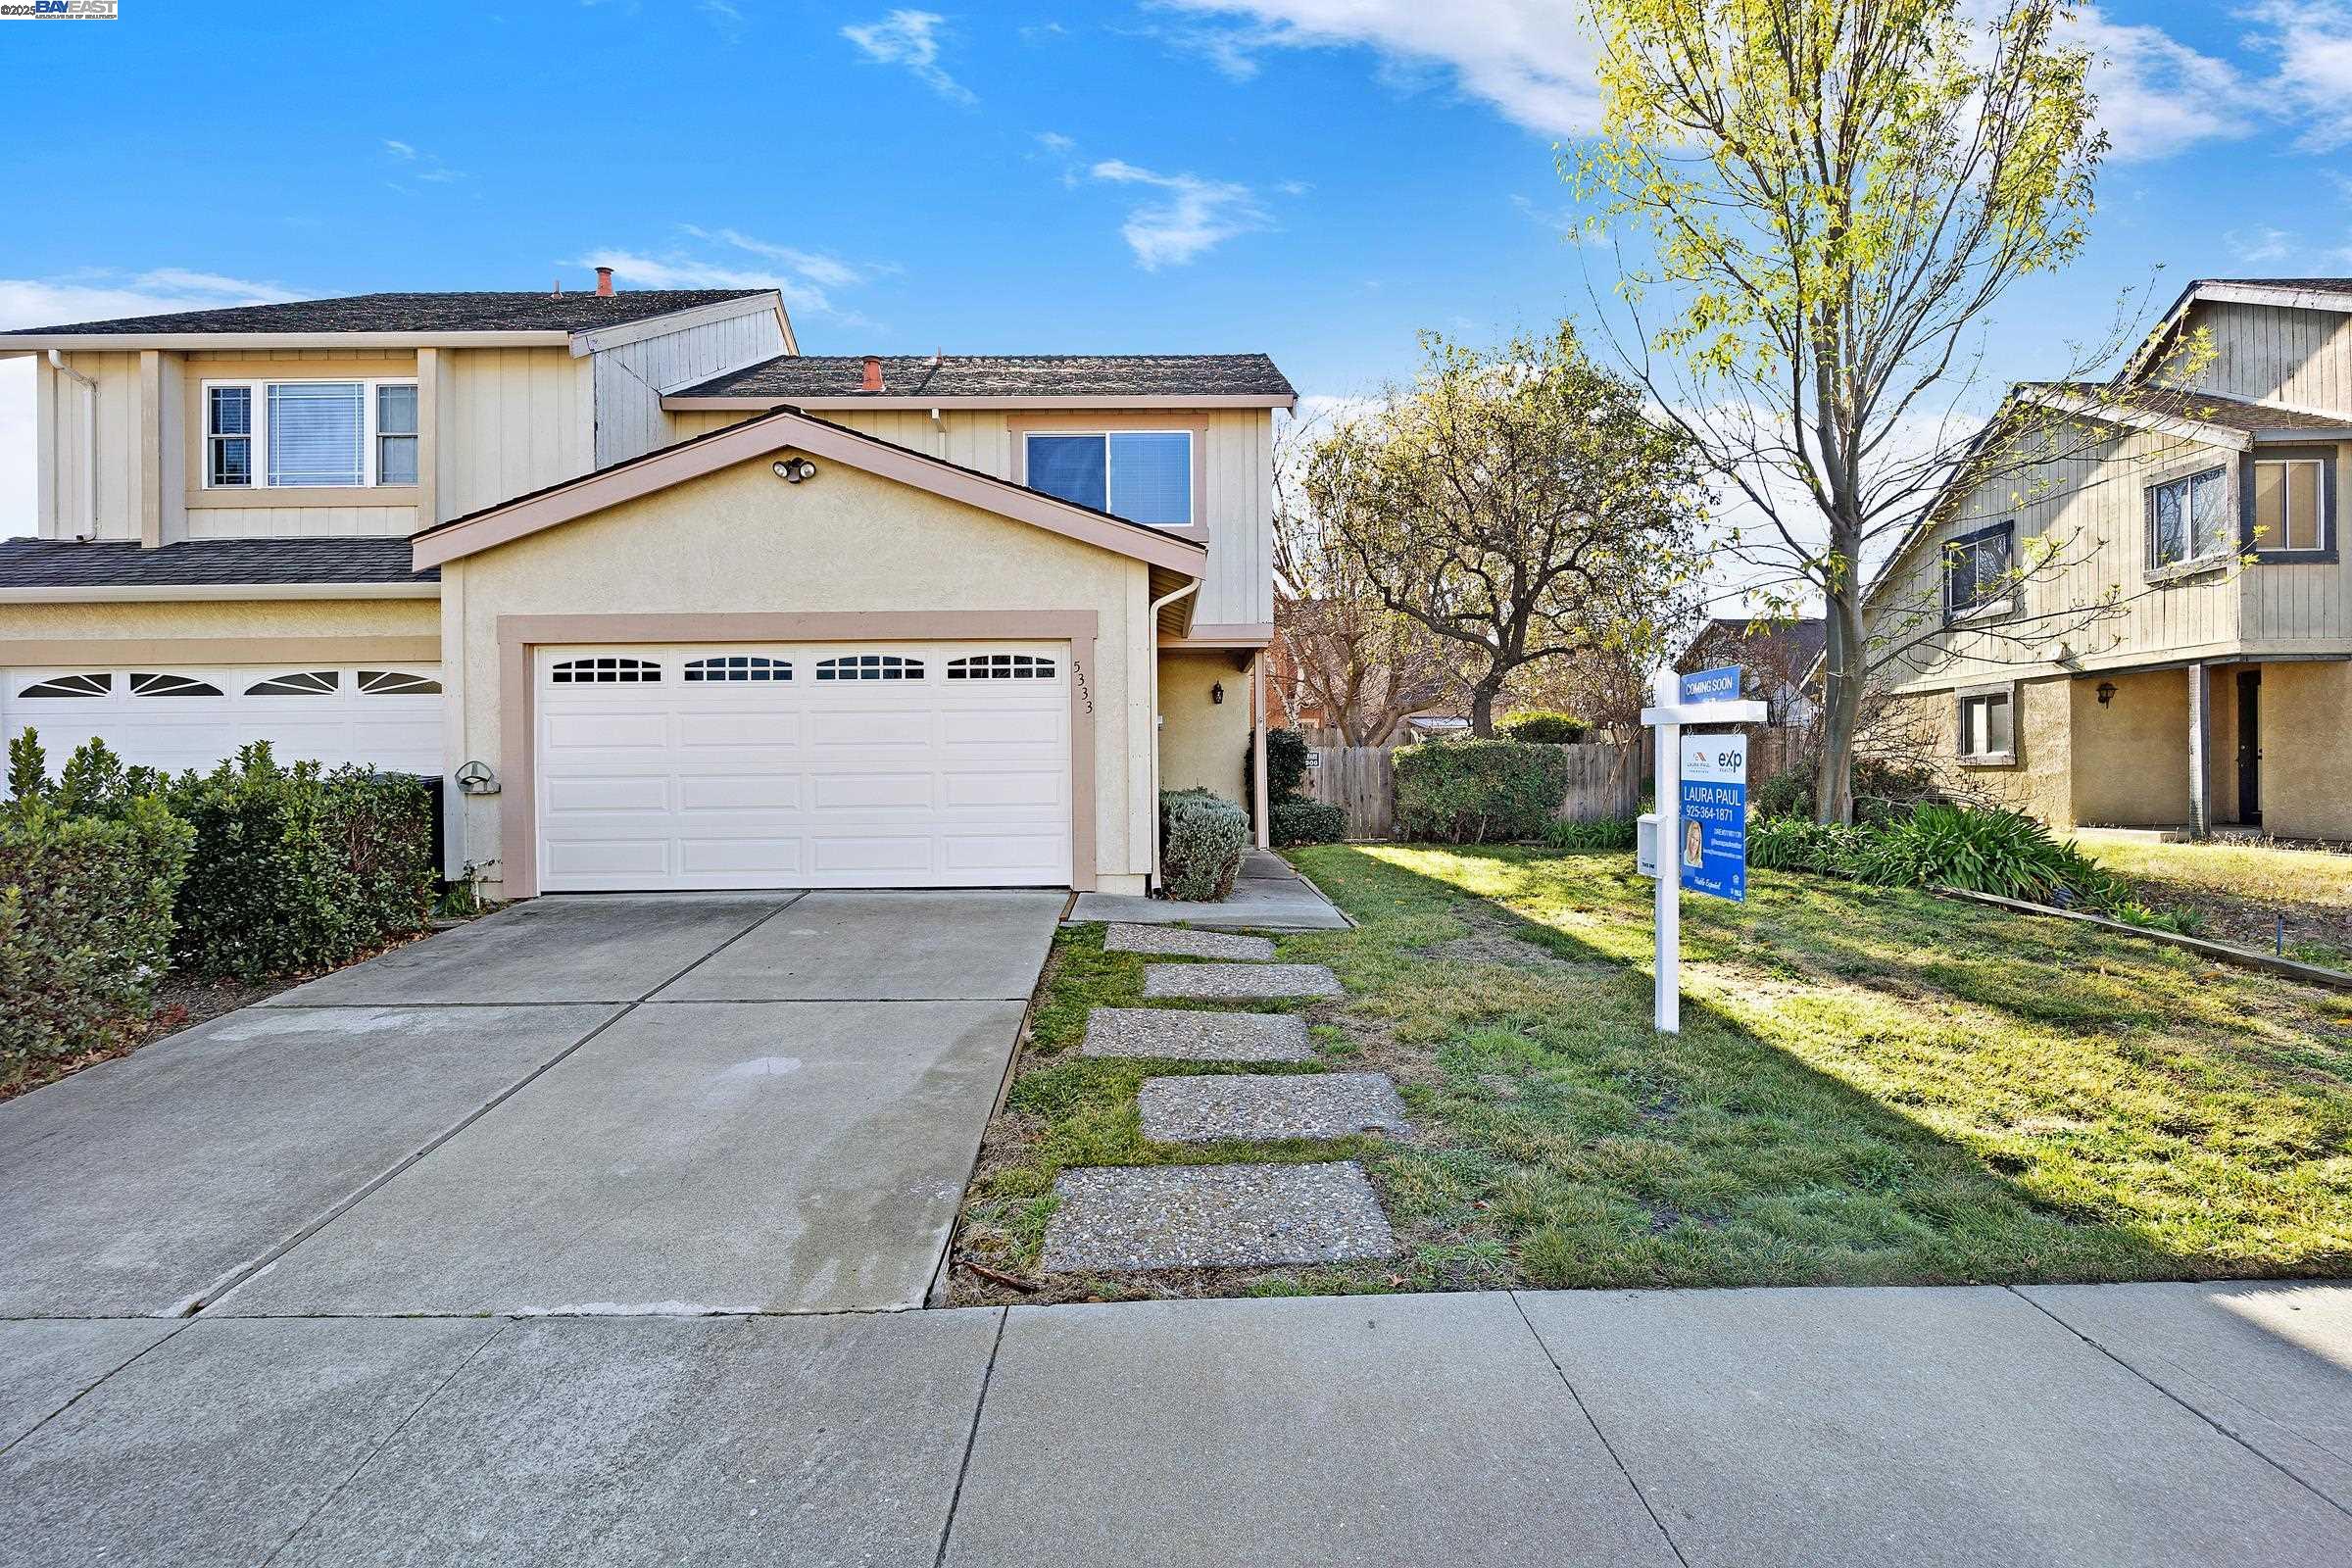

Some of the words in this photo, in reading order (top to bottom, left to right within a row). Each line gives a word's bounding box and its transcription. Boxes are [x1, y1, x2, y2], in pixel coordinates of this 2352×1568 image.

[1073, 661, 1093, 714] 5333
[1686, 680, 1711, 696] COMING
[1712, 676, 1733, 691] SOON
[1684, 786, 1714, 804] LAURA
[1716, 788, 1741, 807] PAUL
[1686, 805, 1733, 822] 925-364-1871
